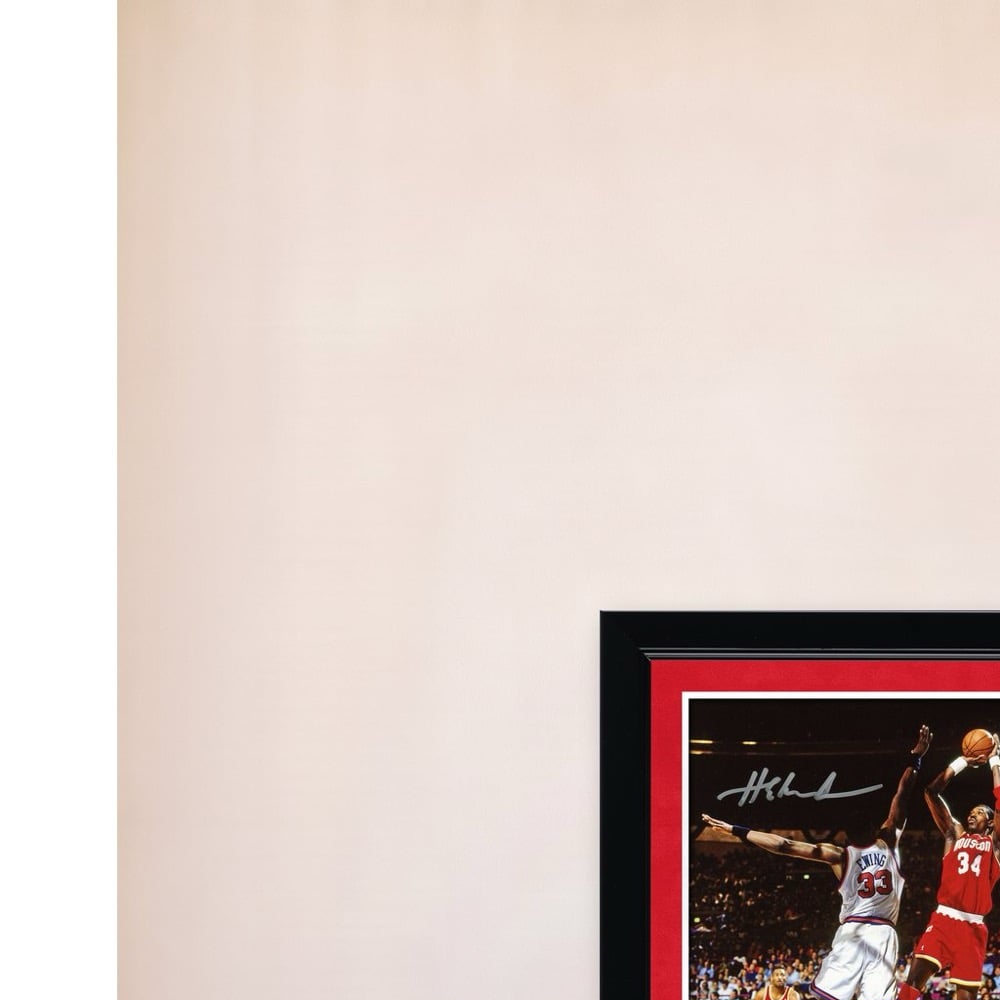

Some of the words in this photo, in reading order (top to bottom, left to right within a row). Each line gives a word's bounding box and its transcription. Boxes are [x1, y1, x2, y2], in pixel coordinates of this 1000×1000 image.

[856, 852, 887, 871] EWING
[957, 851, 983, 877] 34
[857, 869, 893, 899] 33
